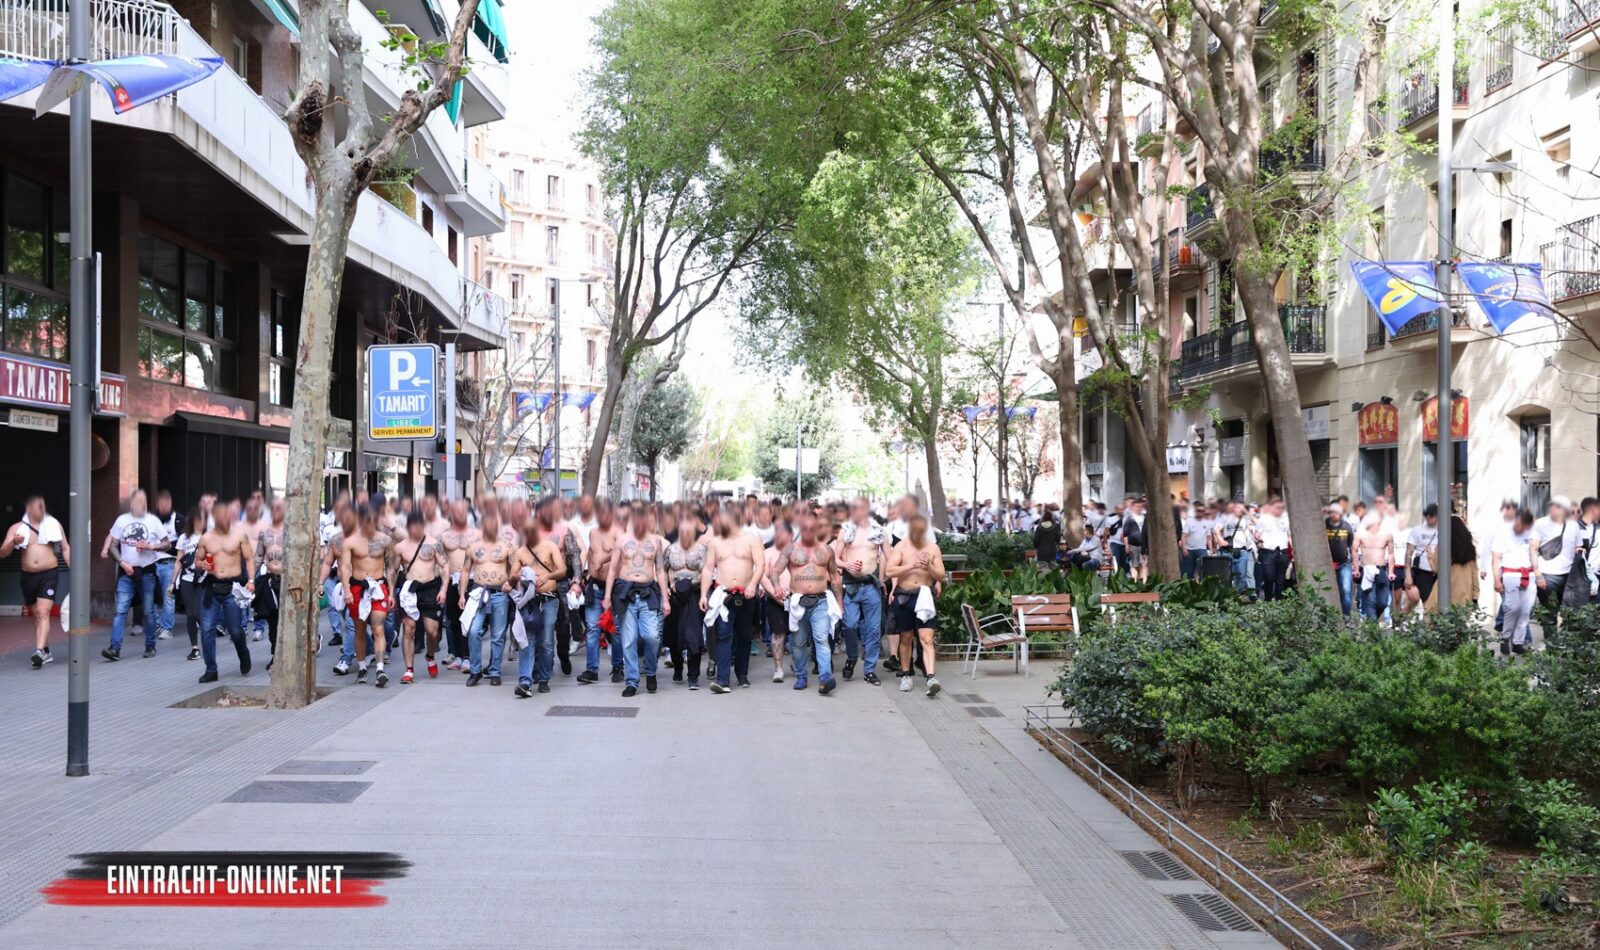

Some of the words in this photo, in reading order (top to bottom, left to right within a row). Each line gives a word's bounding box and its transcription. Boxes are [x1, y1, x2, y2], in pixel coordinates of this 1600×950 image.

[390, 350, 417, 391] P
[378, 394, 426, 413] TAMARIT
[373, 428, 395, 436] SERVEI
[396, 427, 431, 435] PERMANENT
